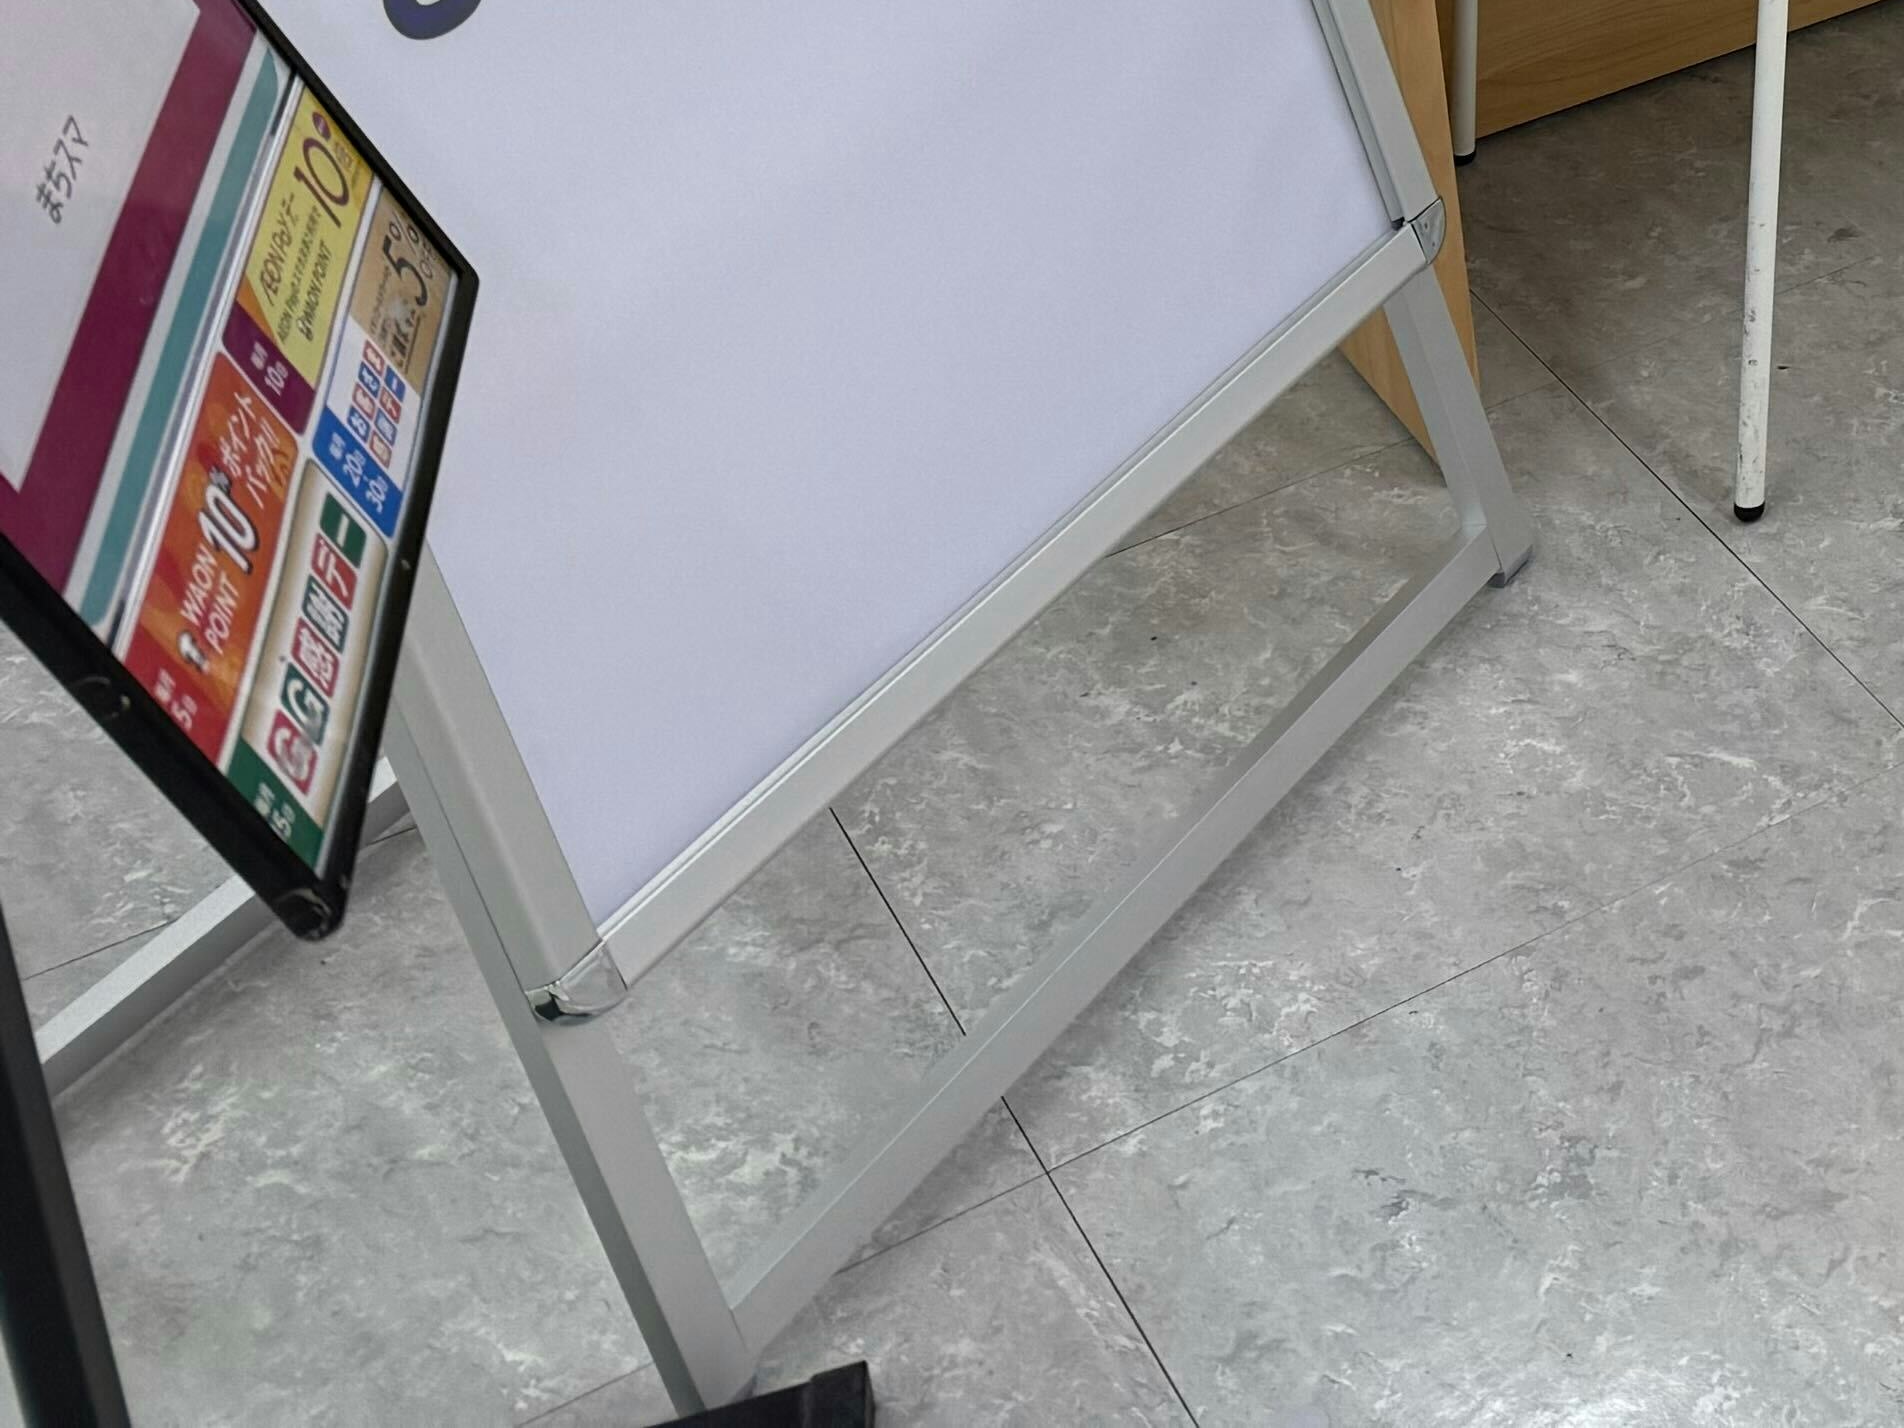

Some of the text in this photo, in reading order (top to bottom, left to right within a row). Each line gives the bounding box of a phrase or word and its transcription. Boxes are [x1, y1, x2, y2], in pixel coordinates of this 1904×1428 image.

[36, 114, 88, 224] まちスマ
[215, 380, 259, 482] ポイント
[179, 539, 218, 633] WAON
[203, 568, 241, 658] POINT
